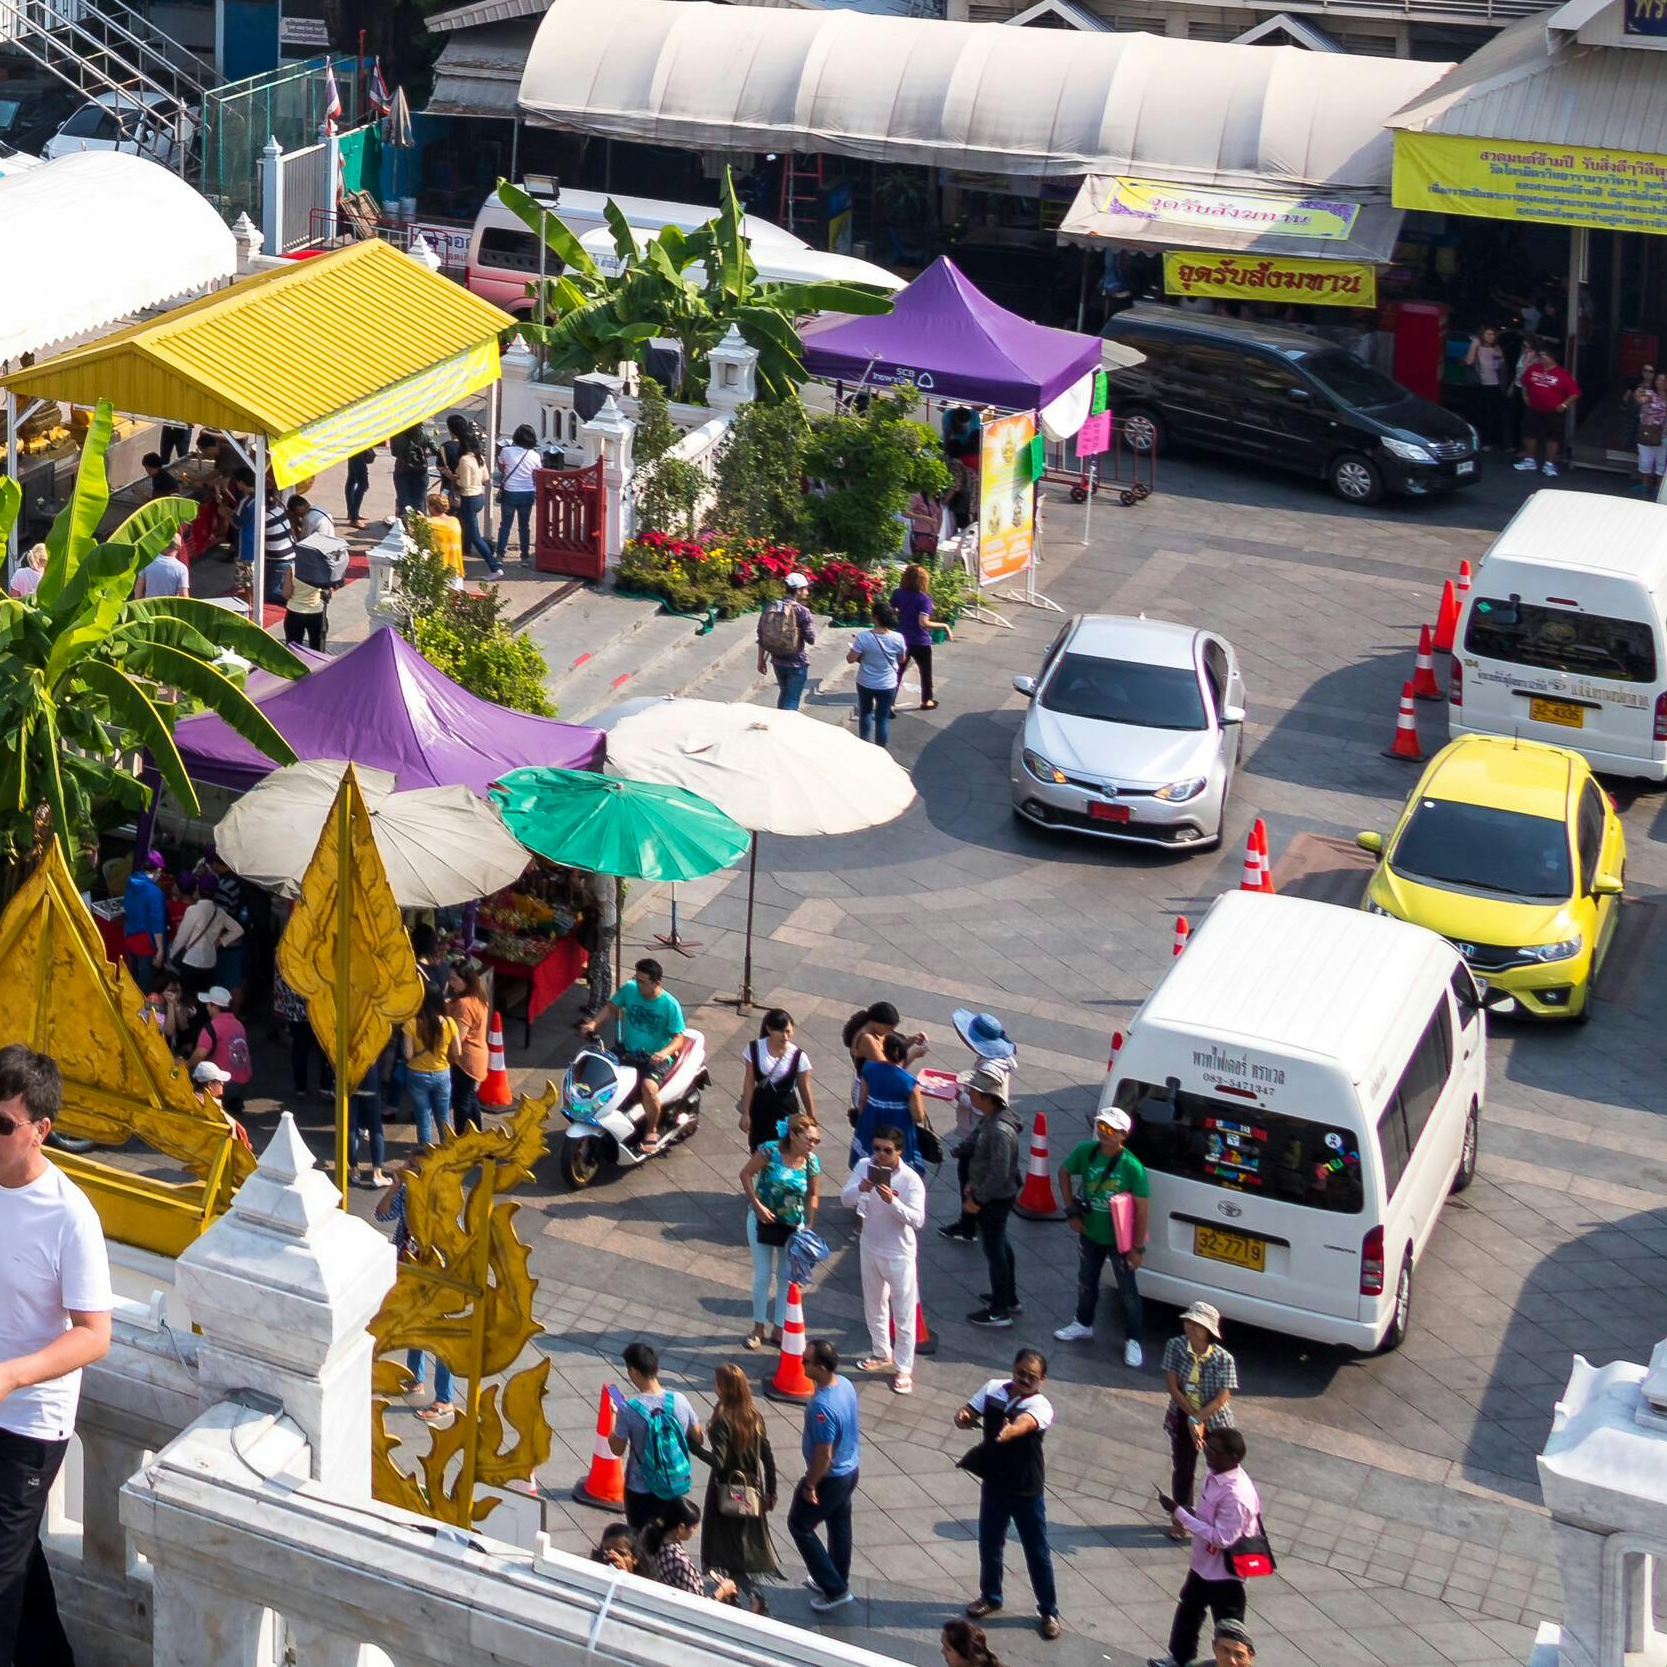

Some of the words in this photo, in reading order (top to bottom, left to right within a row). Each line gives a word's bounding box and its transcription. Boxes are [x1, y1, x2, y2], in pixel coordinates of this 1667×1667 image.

[1178, 259, 1361, 293] จุดรับสังฆทาน
[895, 367, 916, 378] SCB
